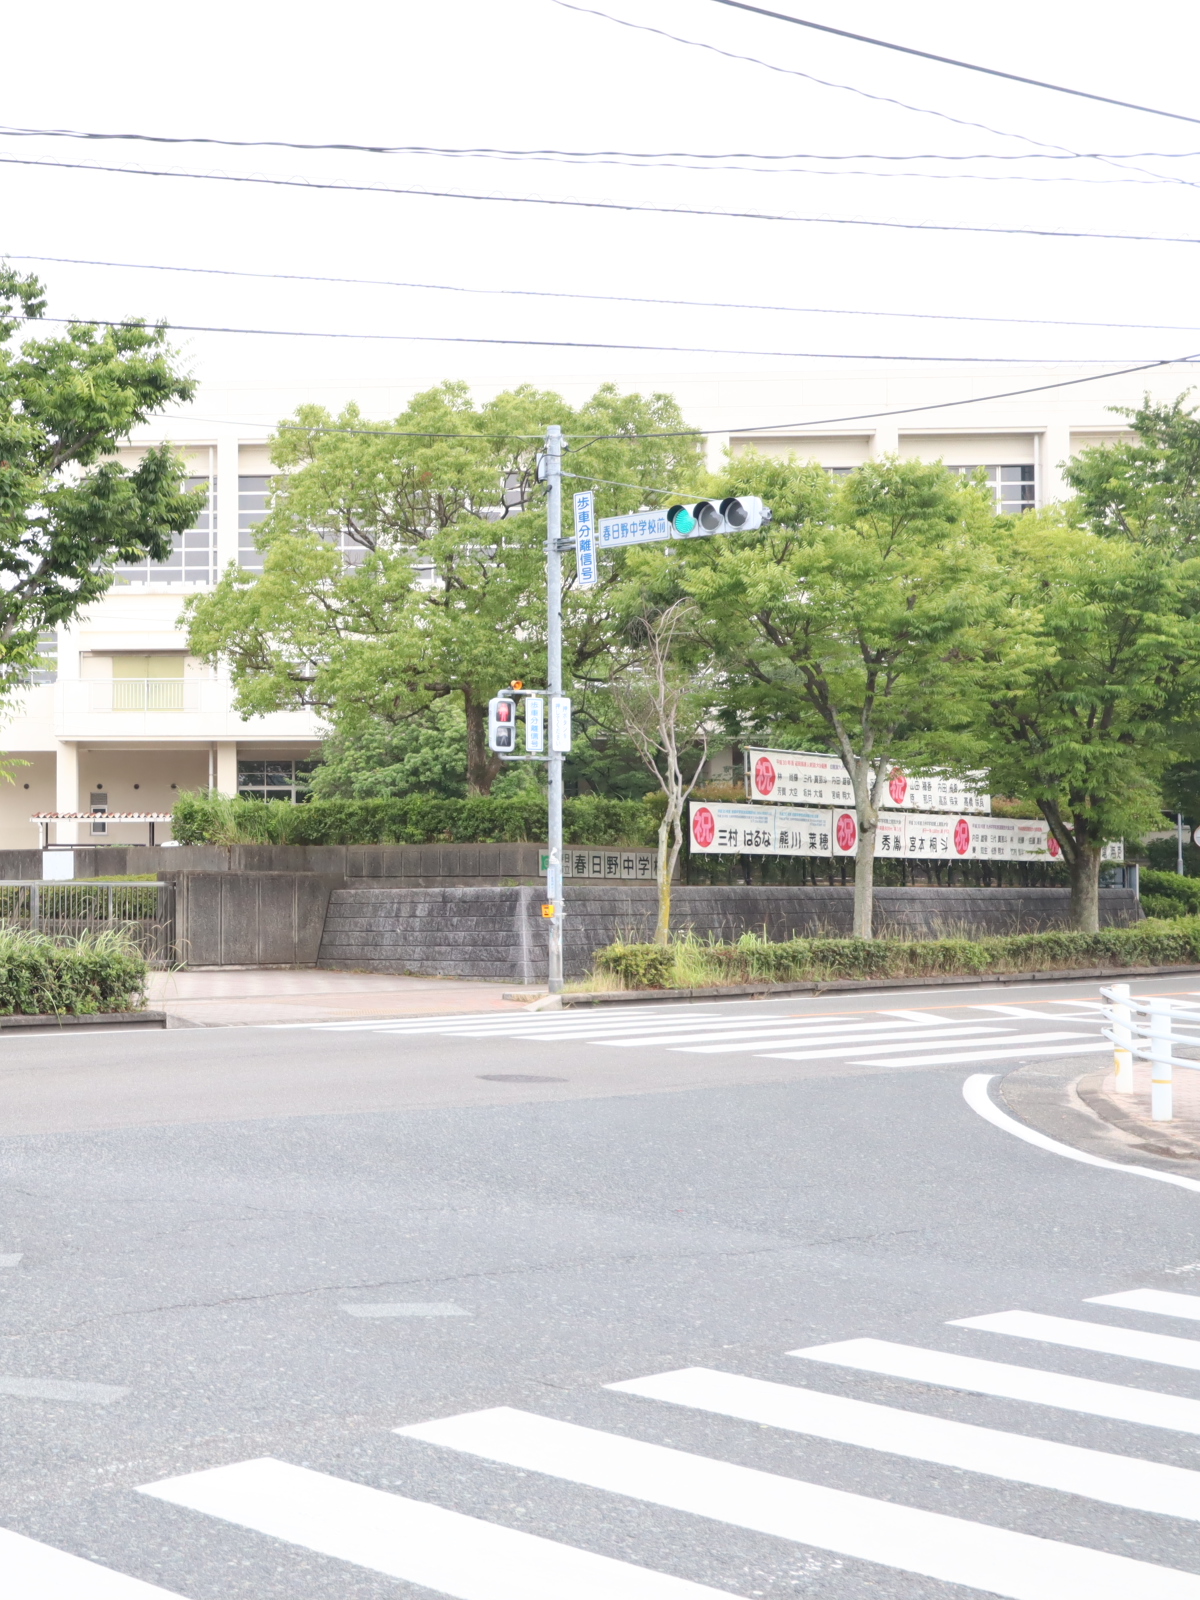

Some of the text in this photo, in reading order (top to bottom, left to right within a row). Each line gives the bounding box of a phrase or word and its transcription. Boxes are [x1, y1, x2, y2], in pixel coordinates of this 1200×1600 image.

[577, 496, 594, 580] 歩車分離信号
[602, 517, 666, 542] 春日野中学校前
[530, 701, 539, 753] 歩車分離信号
[756, 760, 773, 791] 祝
[694, 811, 713, 843] 祝
[717, 828, 772, 848] 三村 はるな
[779, 830, 802, 849] 熊川
[837, 818, 854, 847] 祝
[954, 823, 968, 851] 祝
[909, 836, 926, 853] 宮本
